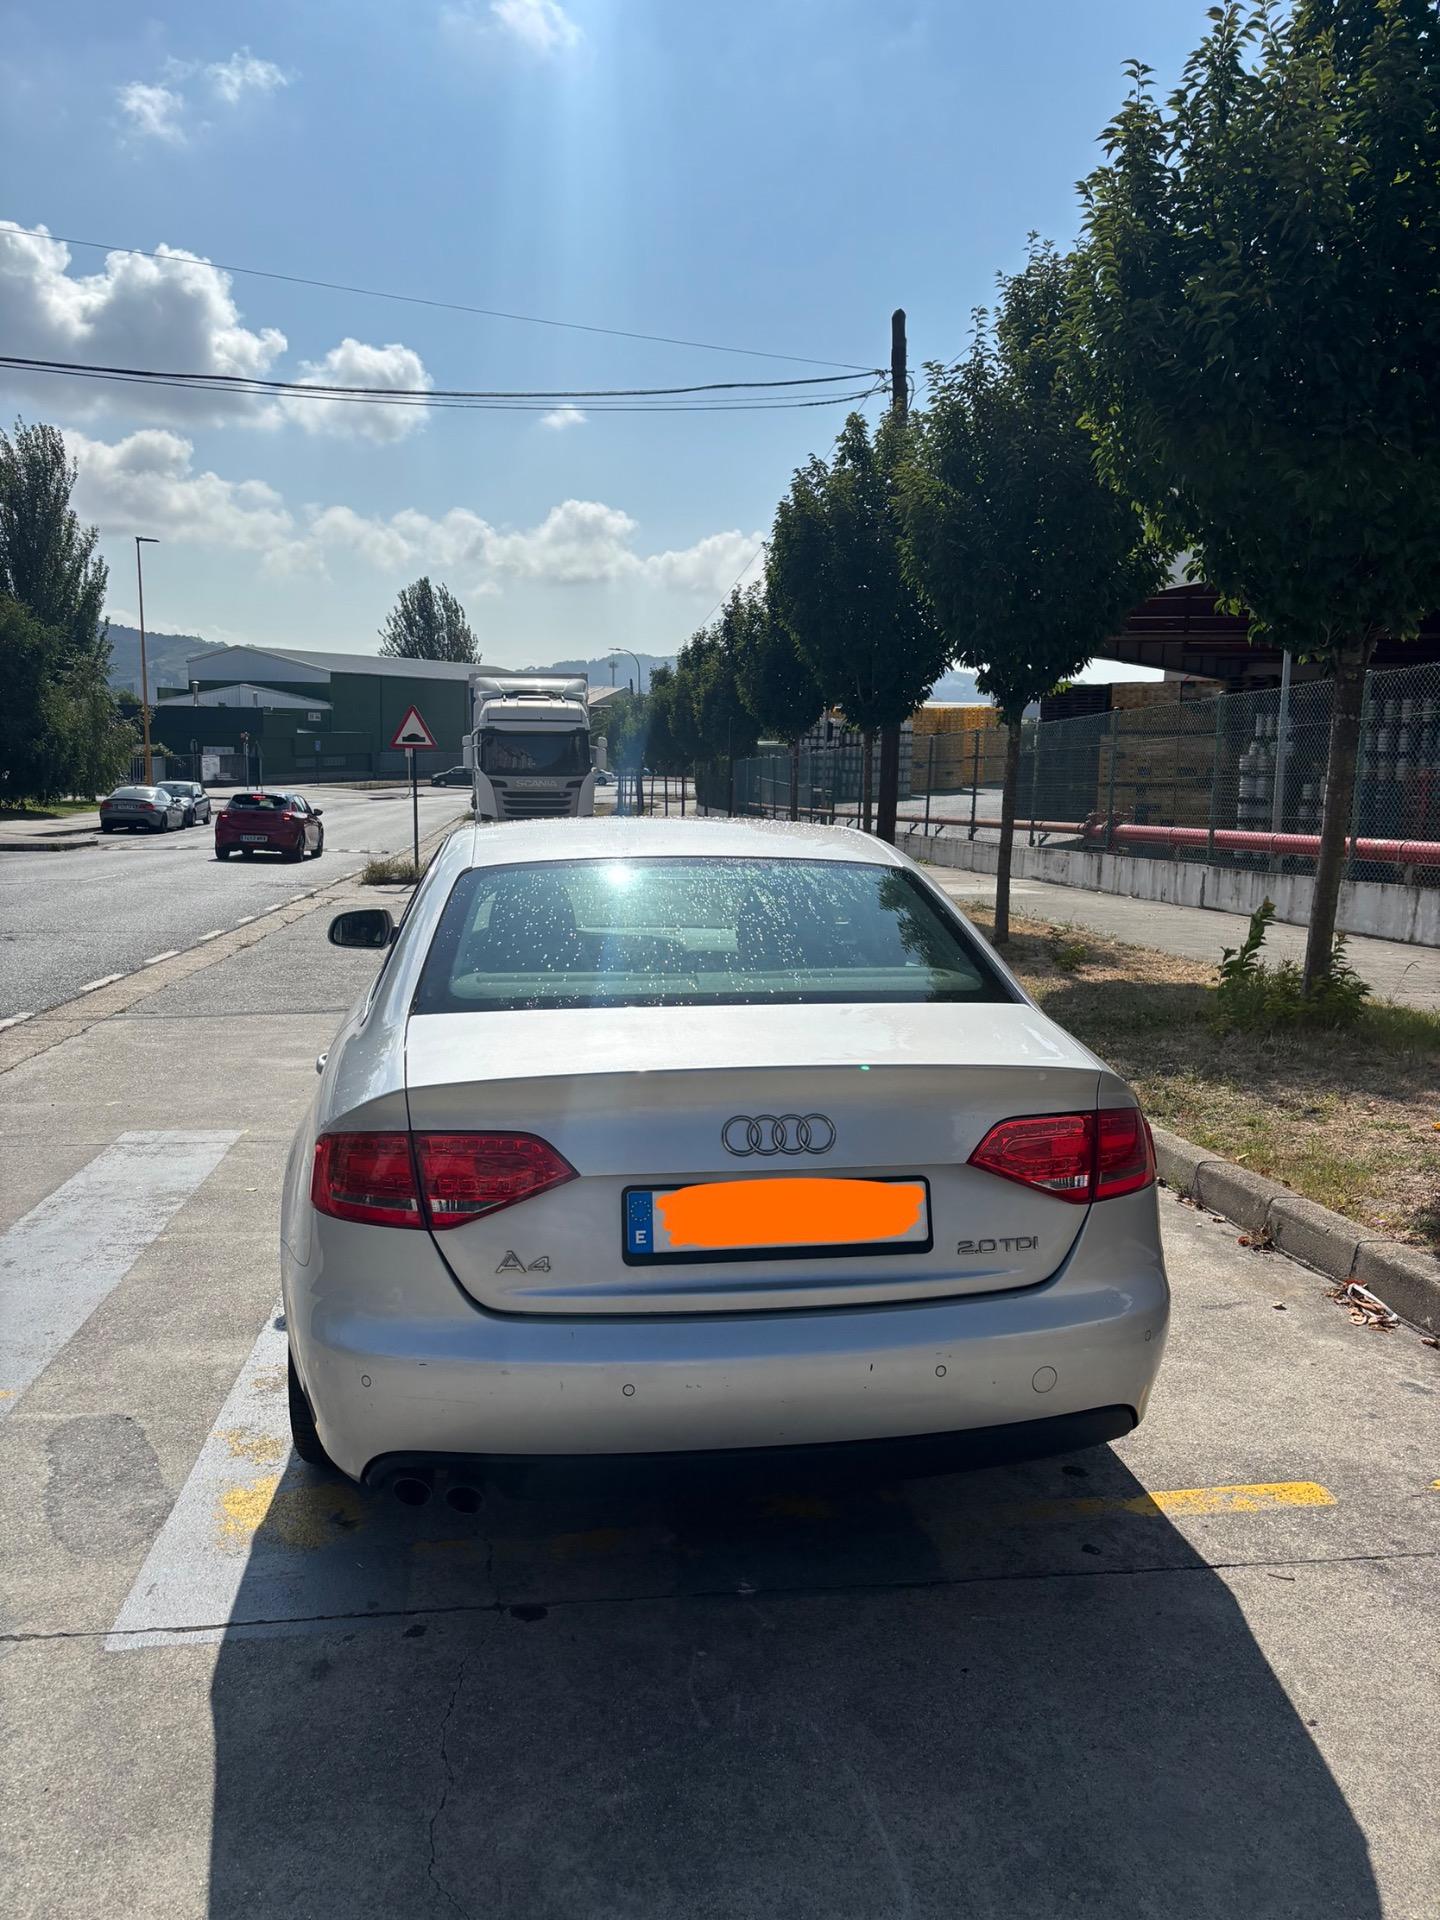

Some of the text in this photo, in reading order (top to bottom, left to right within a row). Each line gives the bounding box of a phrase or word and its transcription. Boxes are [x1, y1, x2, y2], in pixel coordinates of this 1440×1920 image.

[635, 1230, 647, 1244] E
[999, 1236, 1039, 1252] TDI
[496, 1250, 551, 1274] A4
